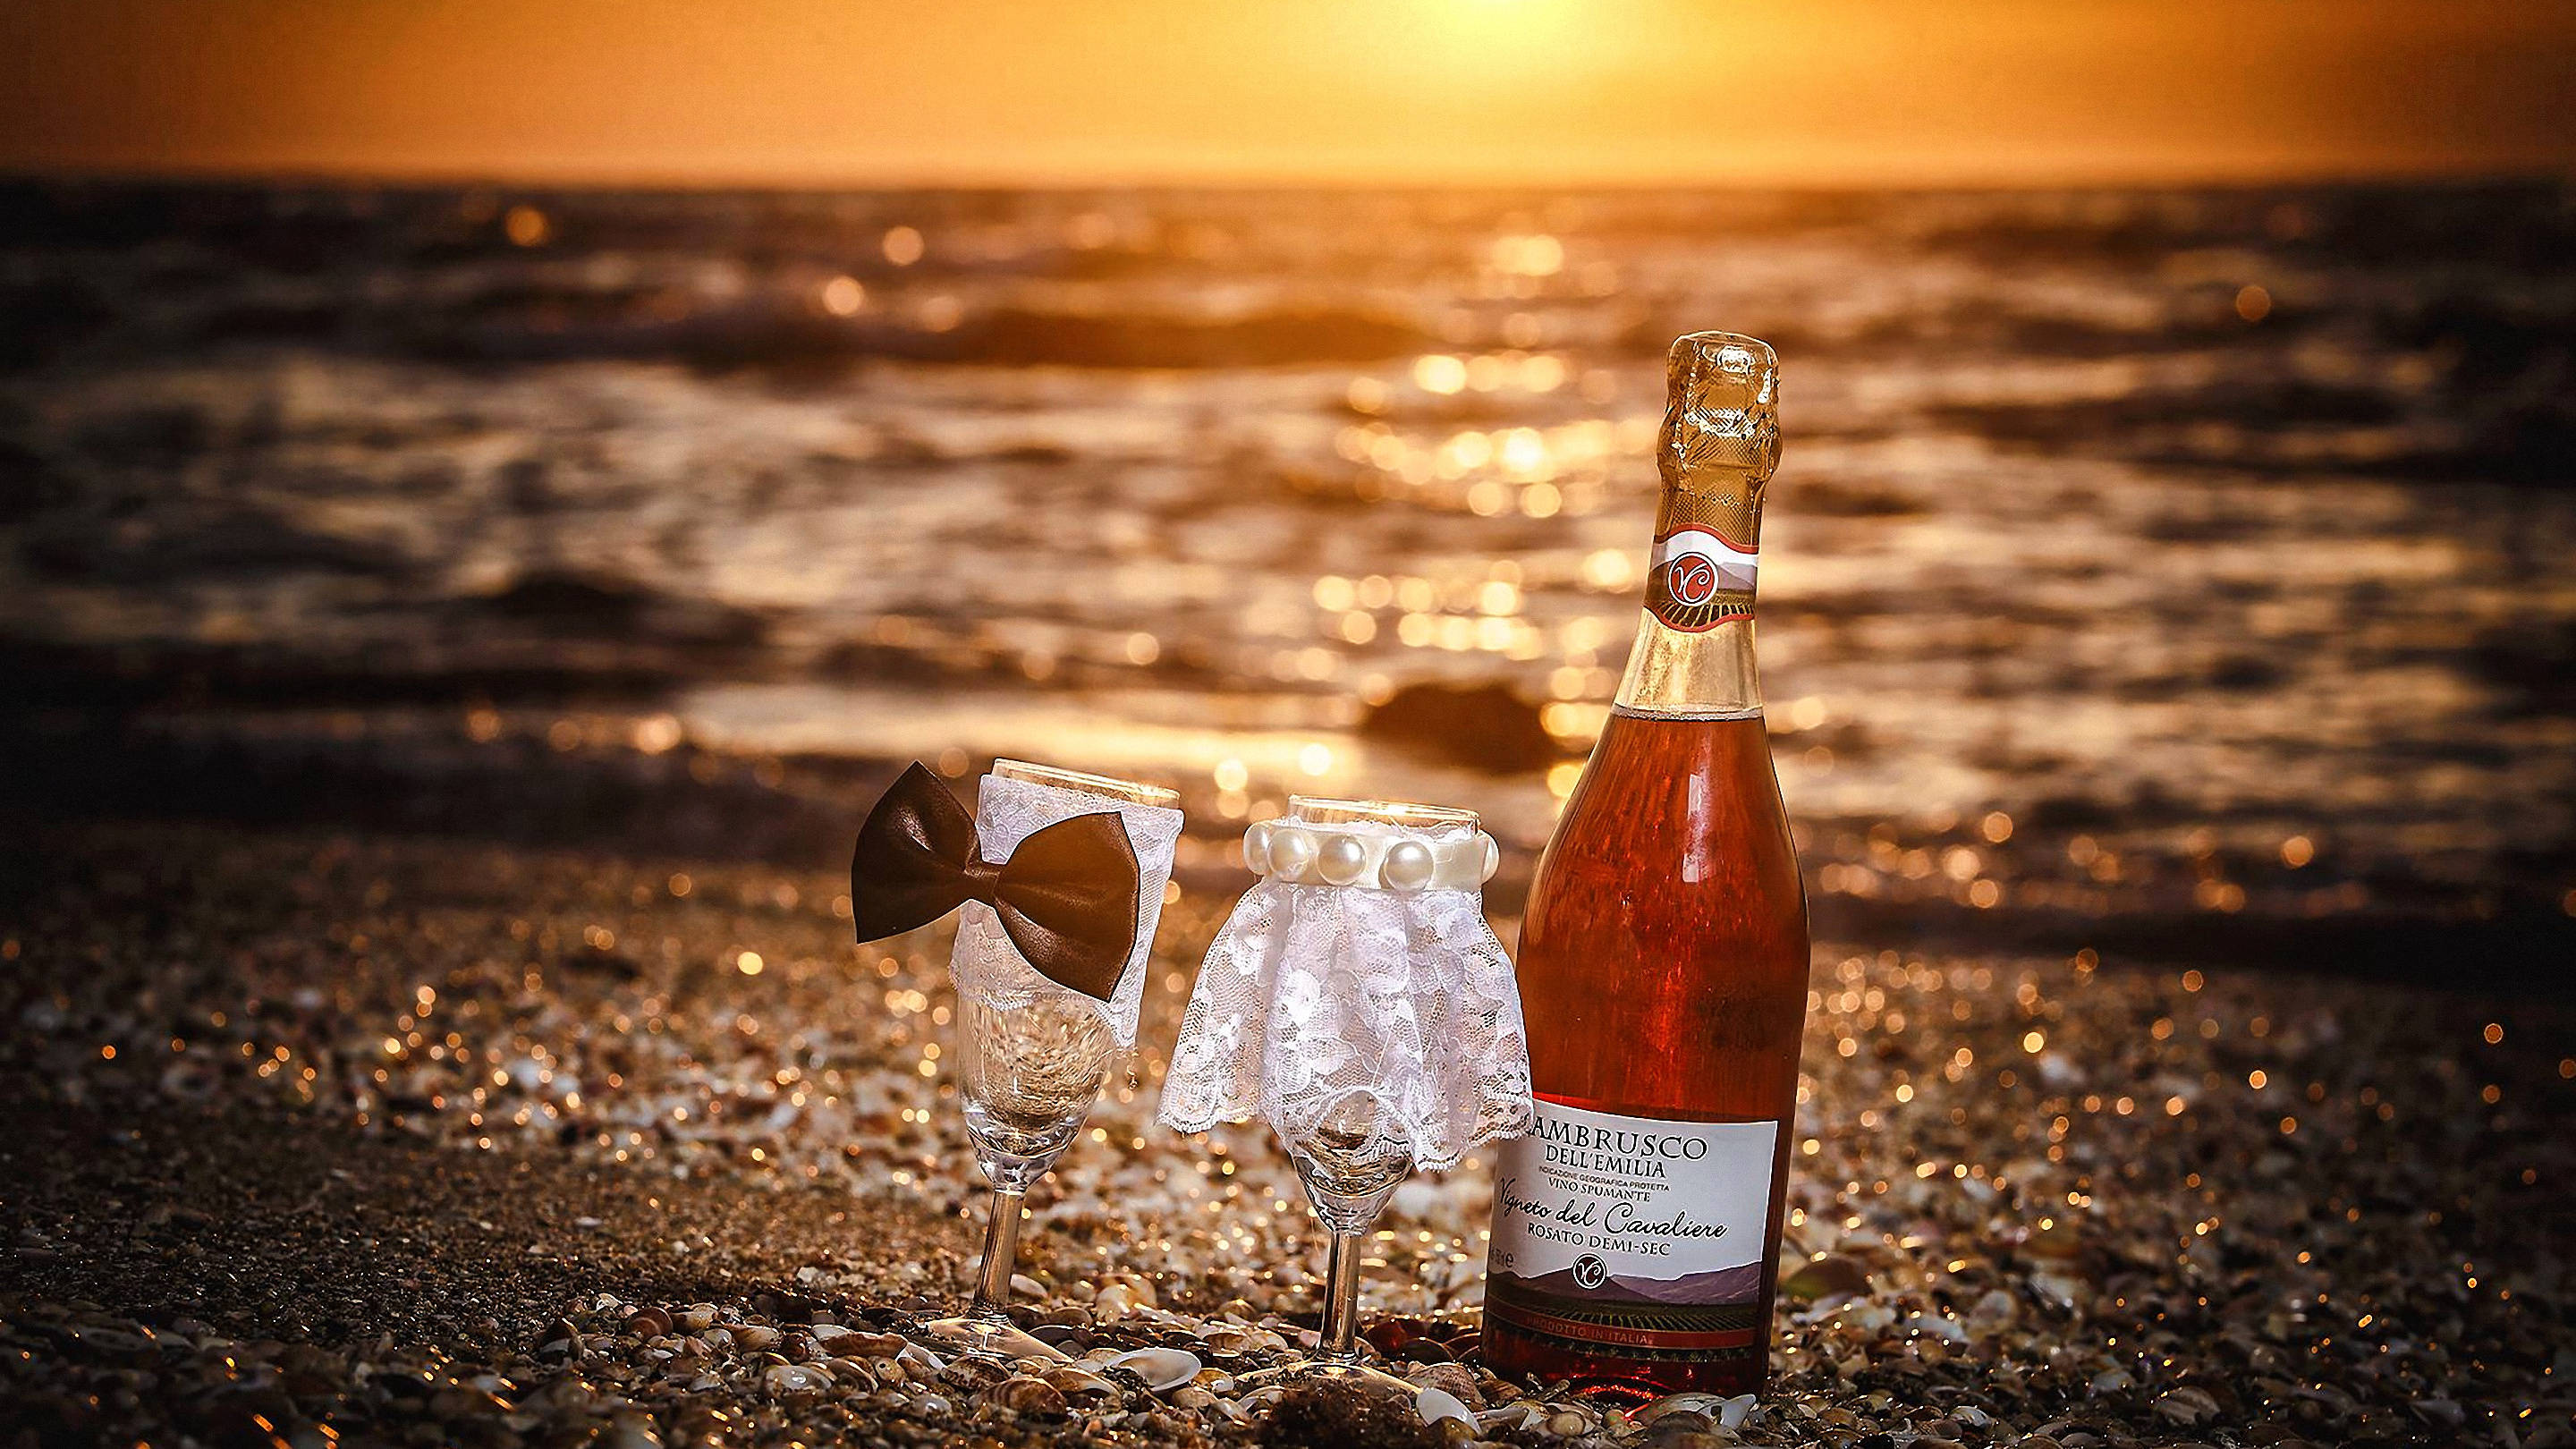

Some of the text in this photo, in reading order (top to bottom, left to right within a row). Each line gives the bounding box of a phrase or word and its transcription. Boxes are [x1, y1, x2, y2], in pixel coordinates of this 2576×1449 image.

[1526, 1116, 1708, 1160] AMBRUSCO
[1546, 1144, 1666, 1179] DELL'EMILIA
[1548, 1177, 1651, 1202] VINO SPUMANTE
[1500, 1177, 1728, 1238] Vigneto del Cavaliere
[1528, 1222, 1671, 1256] ROSATO DEMI-SEC
